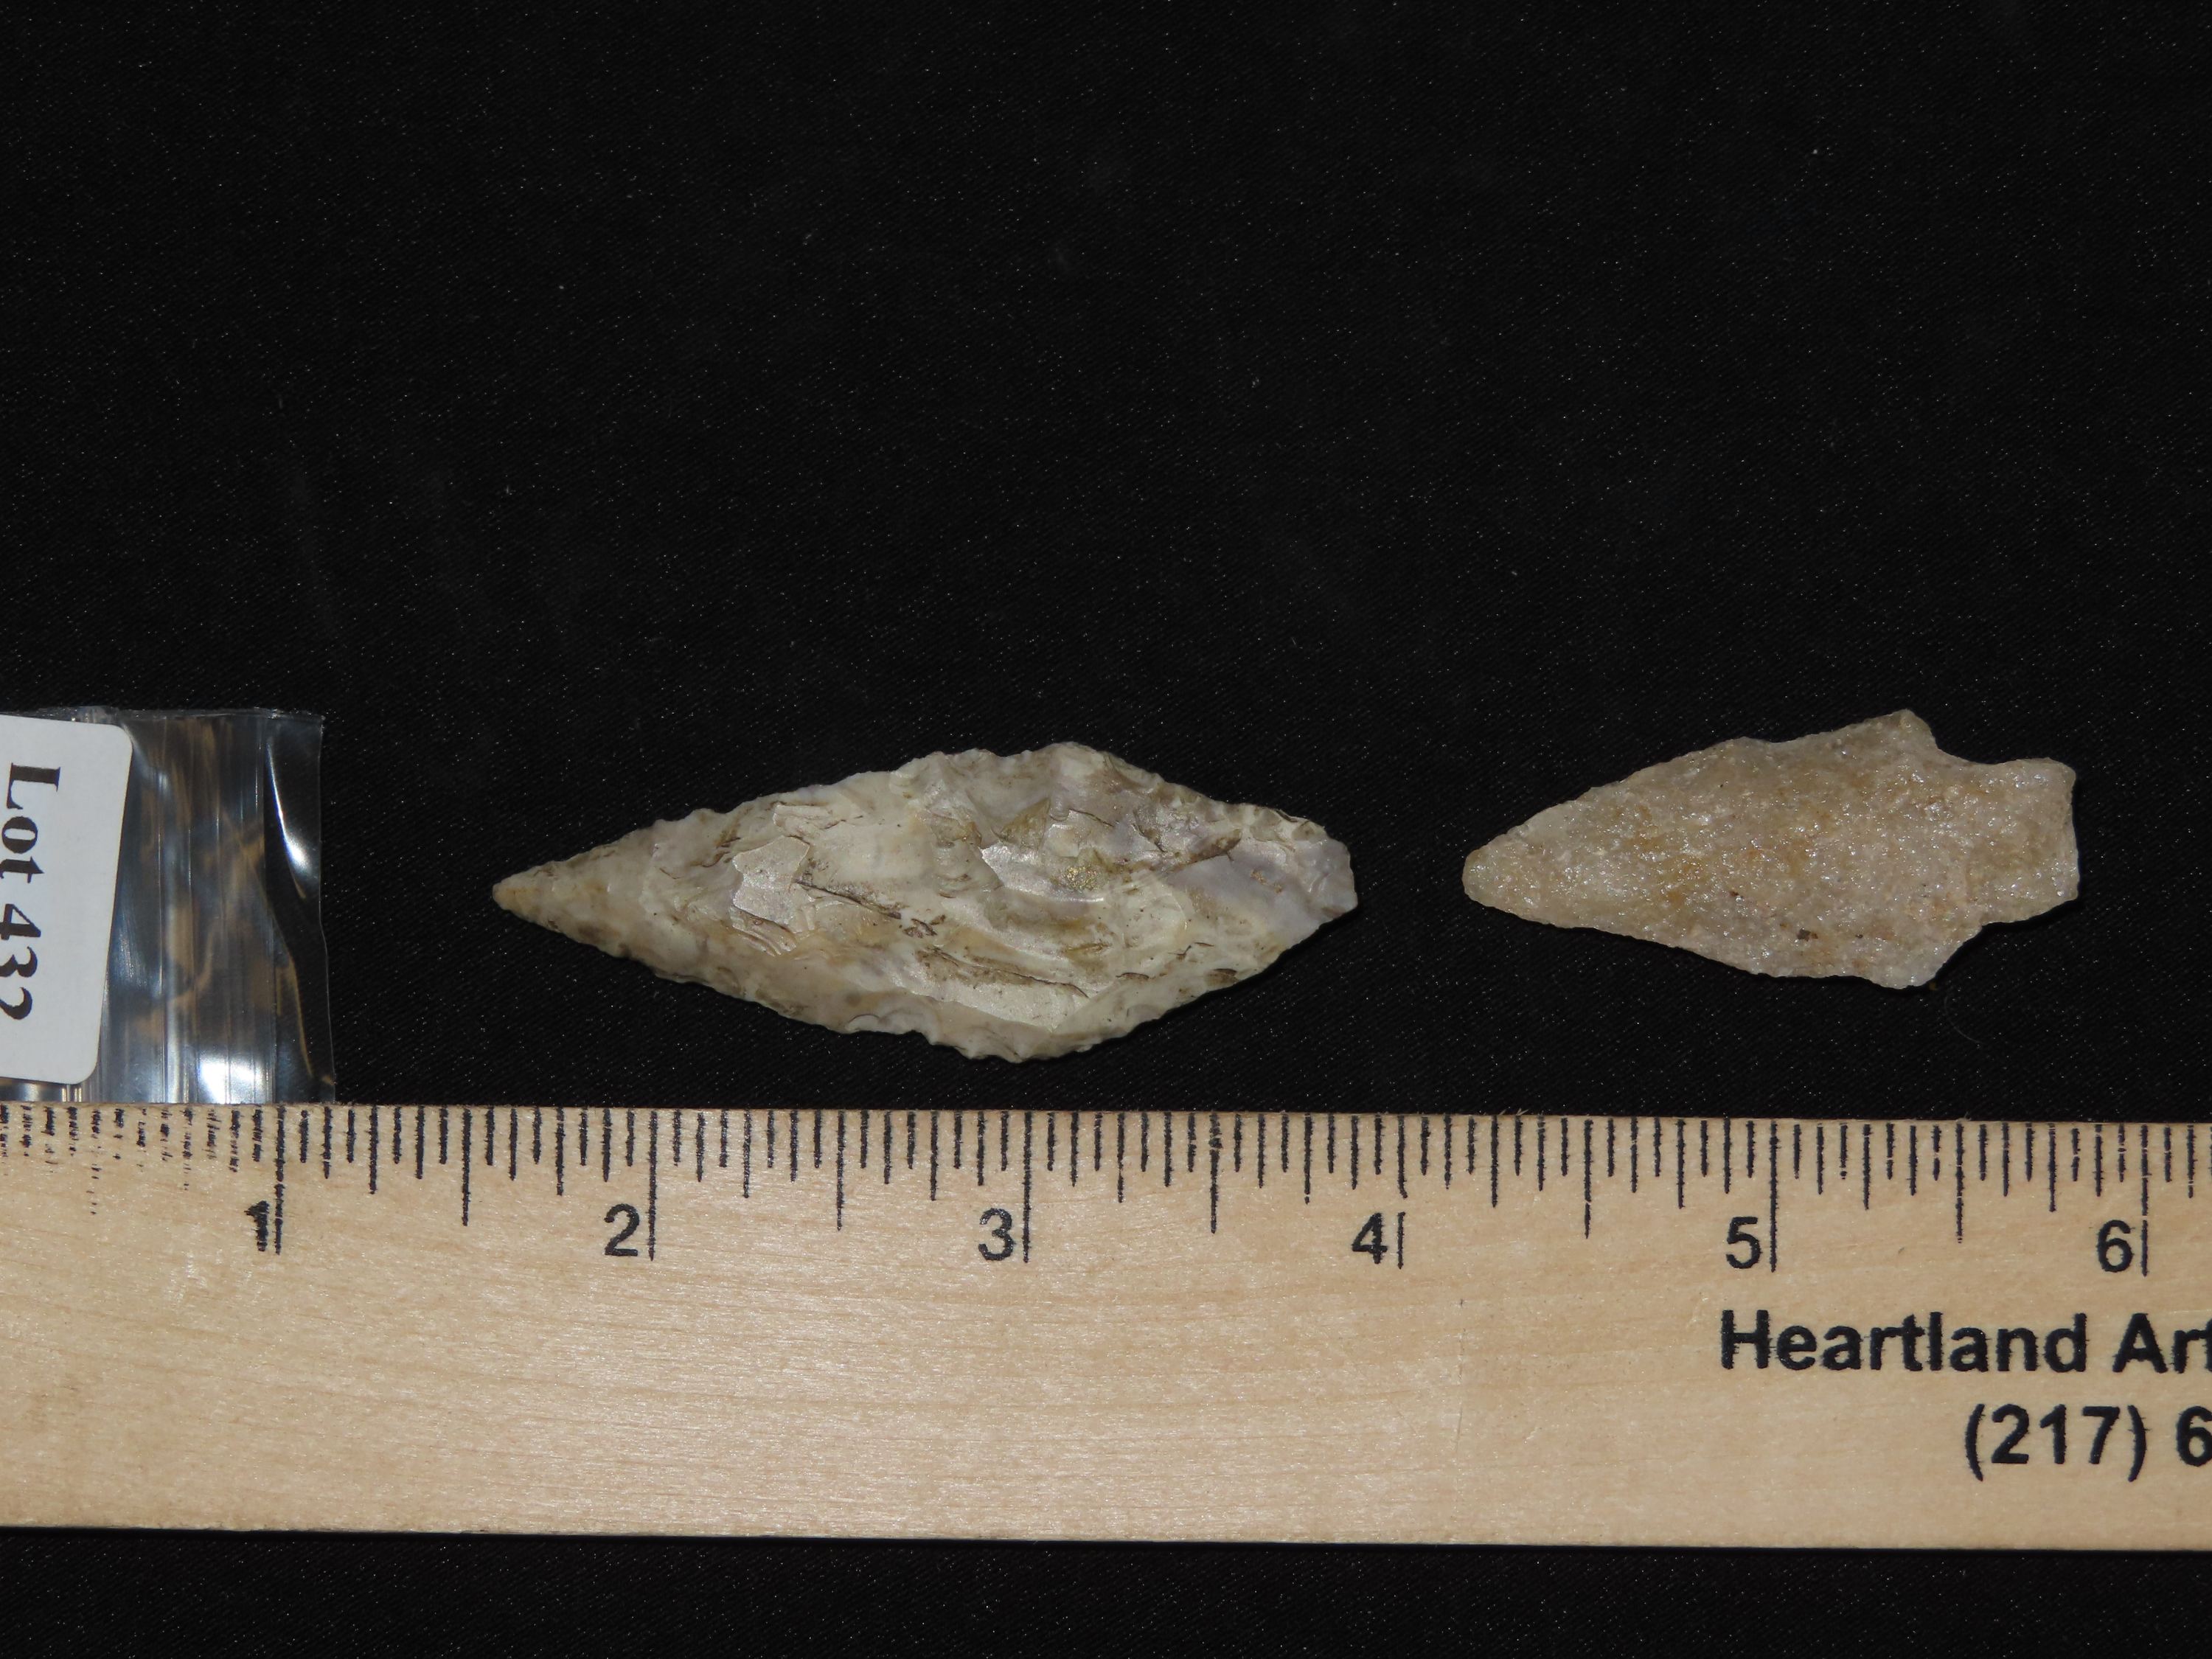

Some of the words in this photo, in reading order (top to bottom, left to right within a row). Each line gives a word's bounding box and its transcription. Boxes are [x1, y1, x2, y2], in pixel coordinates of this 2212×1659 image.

[0, 762, 60, 883] Lot
[244, 1200, 270, 1252] 1
[604, 1203, 640, 1257] 2
[978, 1208, 1016, 1262] 3
[1351, 1212, 1389, 1265] 4
[1725, 1216, 1763, 1270] 5
[2096, 1220, 2135, 1273] 6
[1720, 1310, 2088, 1373] Heartland
[1964, 1403, 2149, 1483] (217)
[2176, 1405, 2212, 1467] 6
